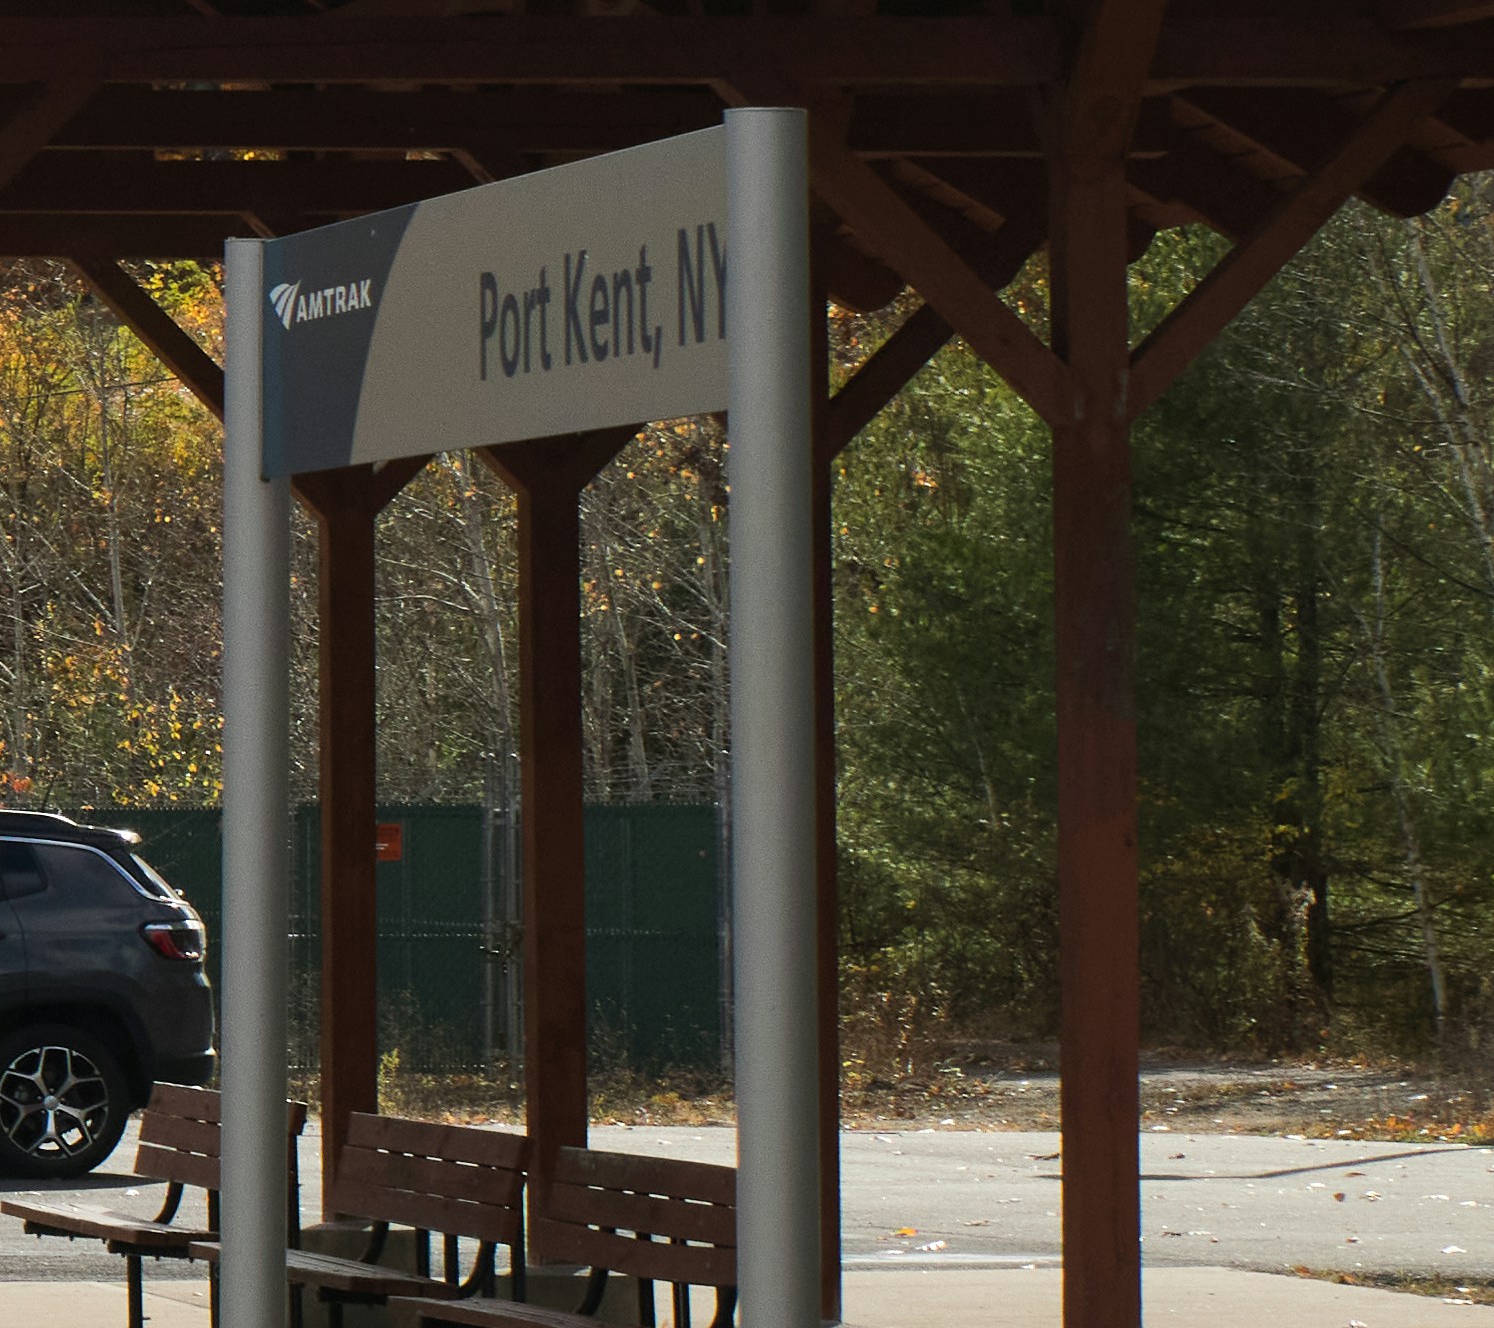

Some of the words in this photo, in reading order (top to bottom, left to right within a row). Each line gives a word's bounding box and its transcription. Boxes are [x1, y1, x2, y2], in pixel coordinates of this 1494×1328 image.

[295, 278, 372, 324] AMTRAK
[478, 266, 552, 381] Port
[563, 244, 663, 369] Kent,
[678, 221, 729, 346] NY
